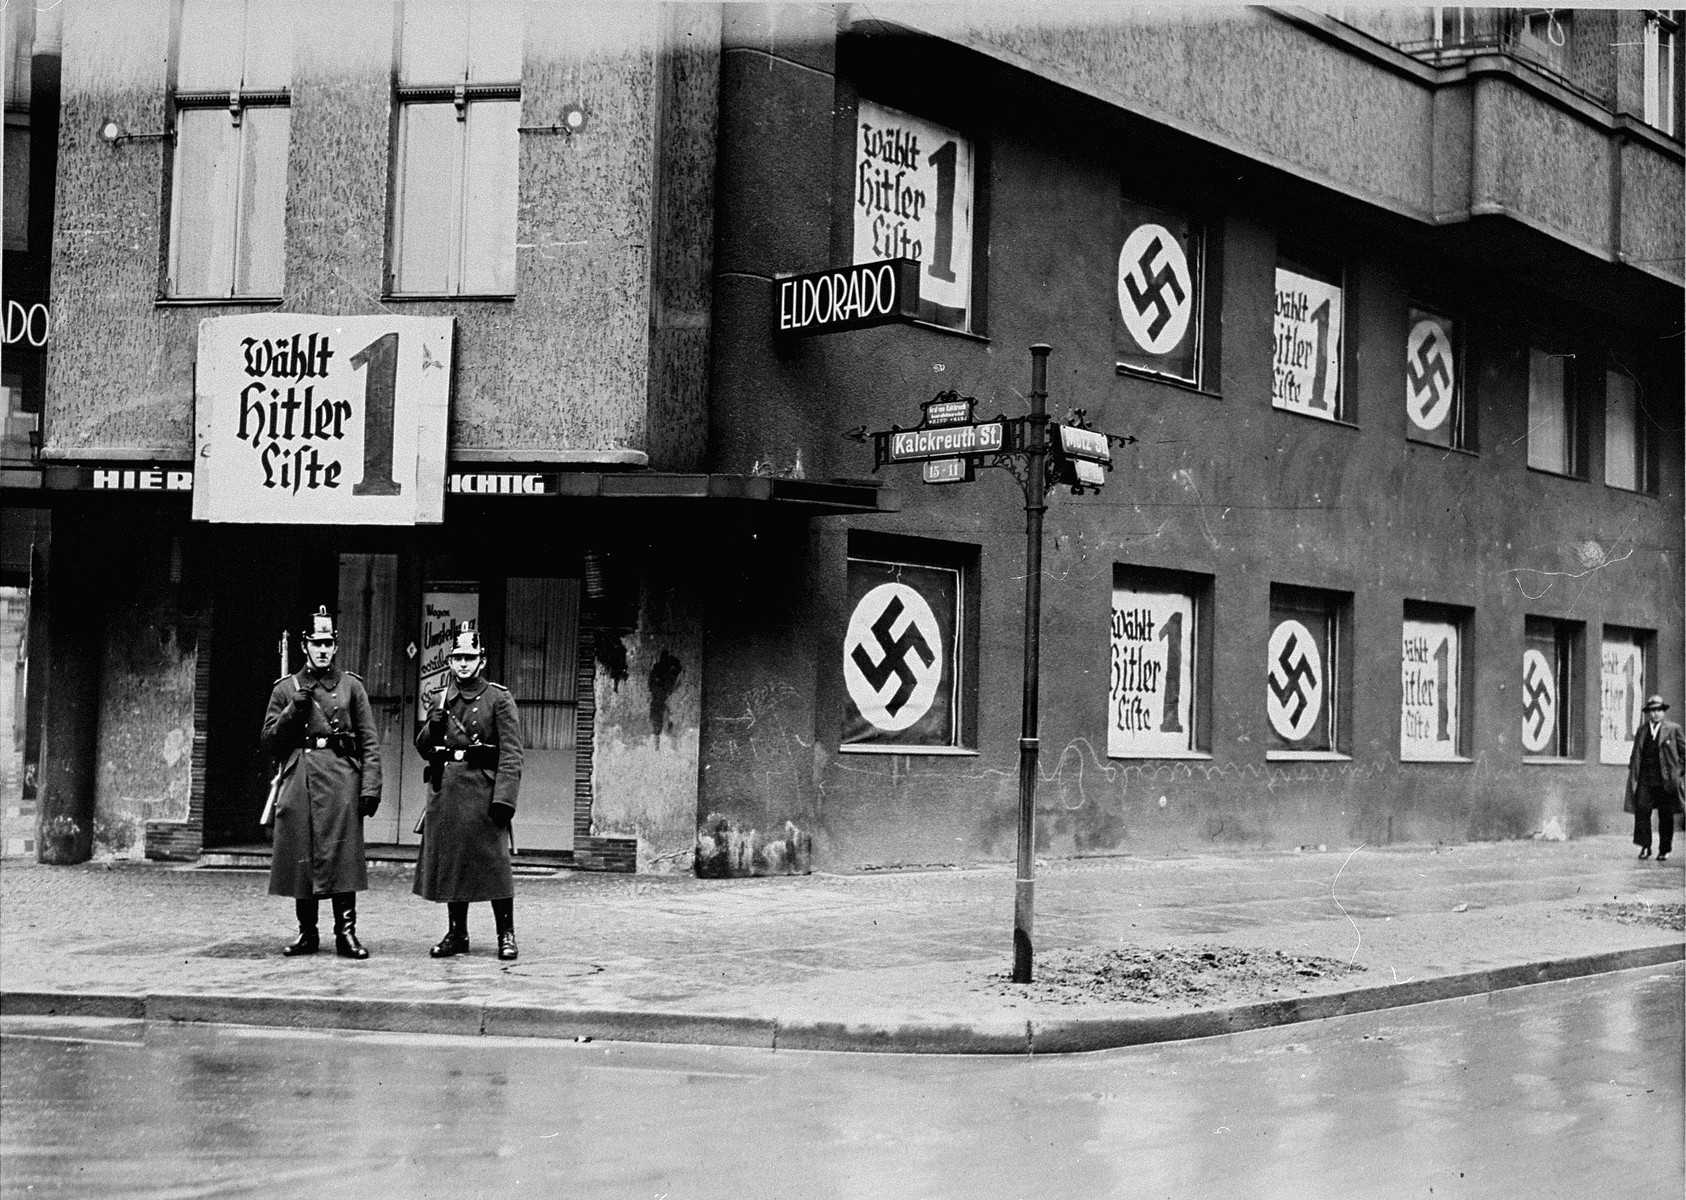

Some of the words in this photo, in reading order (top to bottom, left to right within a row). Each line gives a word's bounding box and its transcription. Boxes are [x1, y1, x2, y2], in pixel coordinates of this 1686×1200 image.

[860, 122, 921, 172] Wählt
[857, 158, 926, 222] Hitler
[927, 140, 958, 284] 1
[780, 264, 896, 330] ELDORADO
[240, 332, 335, 384] Wählt
[1273, 322, 1313, 370] itler
[1308, 298, 1331, 411] 1
[236, 382, 352, 449] Hitler
[349, 332, 402, 496] 1
[895, 428, 976, 454] Kalckreuth
[980, 426, 1000, 446] St.
[93, 470, 193, 490] HIER
[446, 474, 545, 494] ICHTIG
[928, 466, 940, 478] 15
[1158, 611, 1184, 734] 1
[1433, 636, 1450, 742] 1
